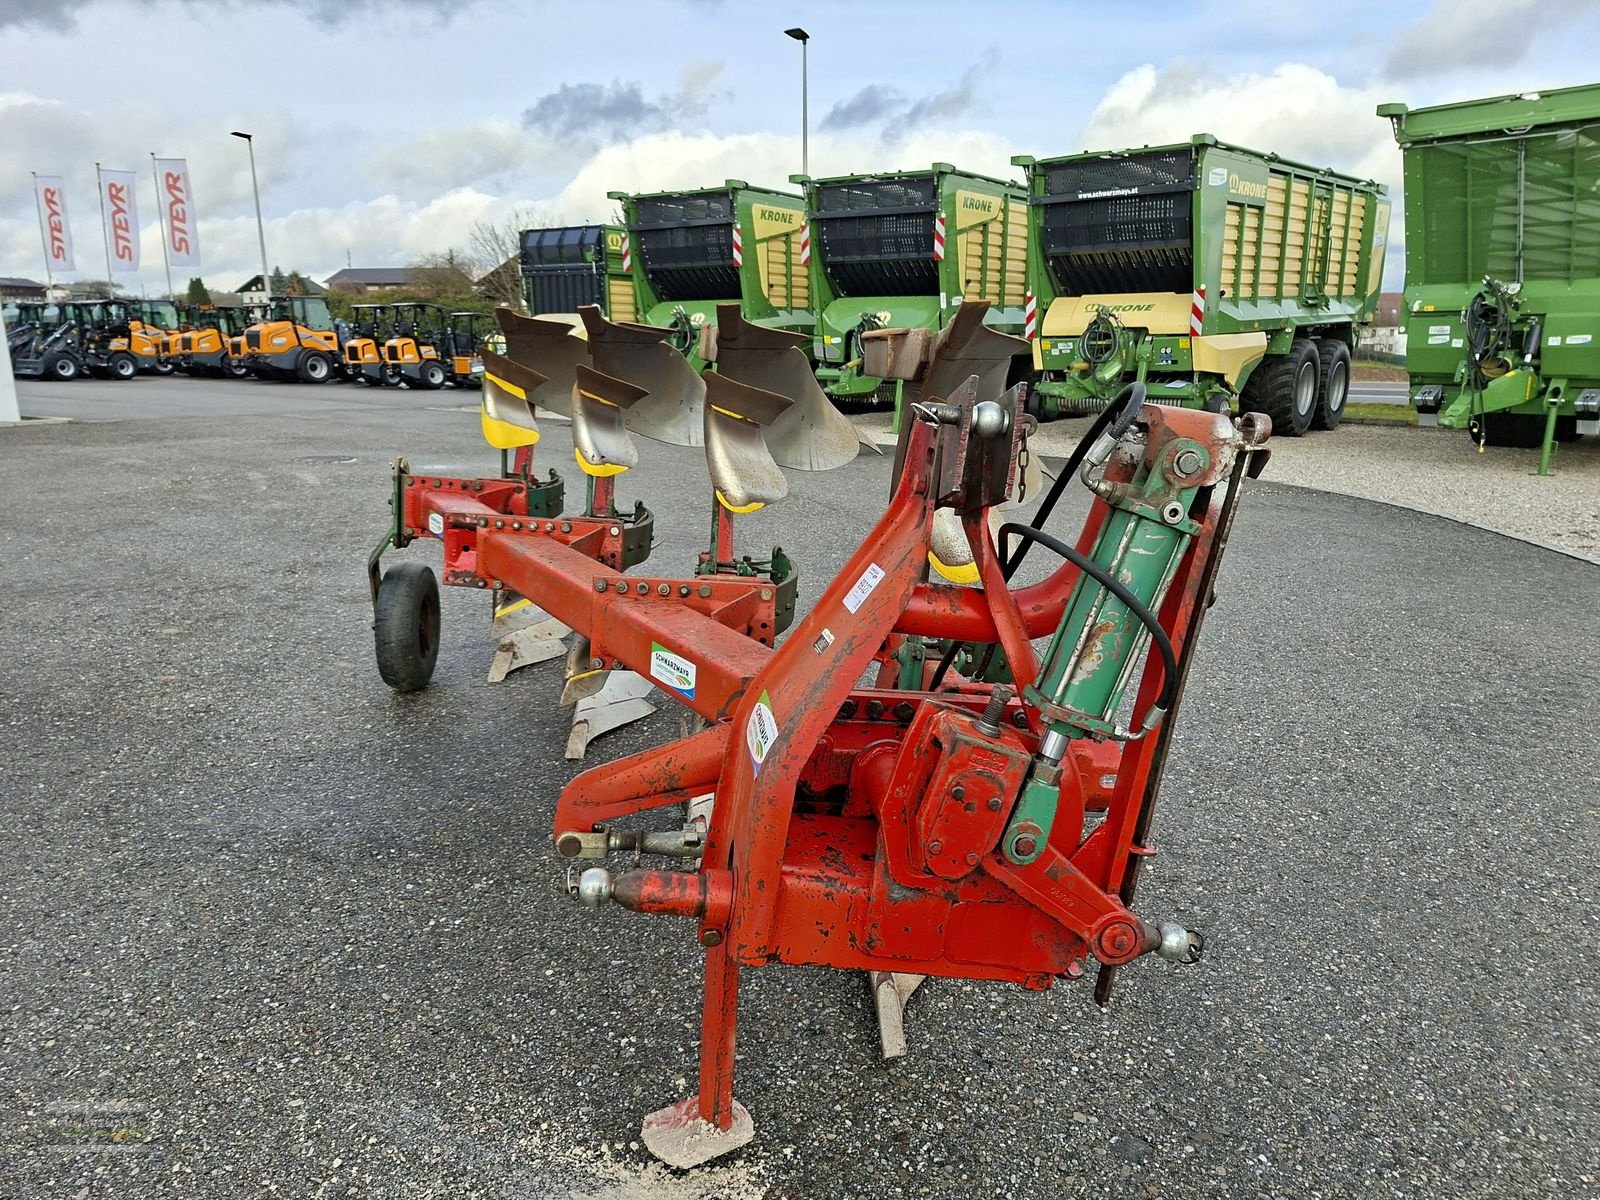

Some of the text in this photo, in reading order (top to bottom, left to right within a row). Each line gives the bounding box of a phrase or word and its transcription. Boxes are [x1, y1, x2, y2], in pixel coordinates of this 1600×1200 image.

[1238, 180, 1267, 198] KRONE
[165, 171, 190, 256] STEYR
[963, 196, 993, 213] KRONE
[44, 187, 66, 262] STEYR
[108, 182, 132, 262] STEYR
[760, 209, 794, 224] KRONE
[1107, 303, 1156, 312] RONE
